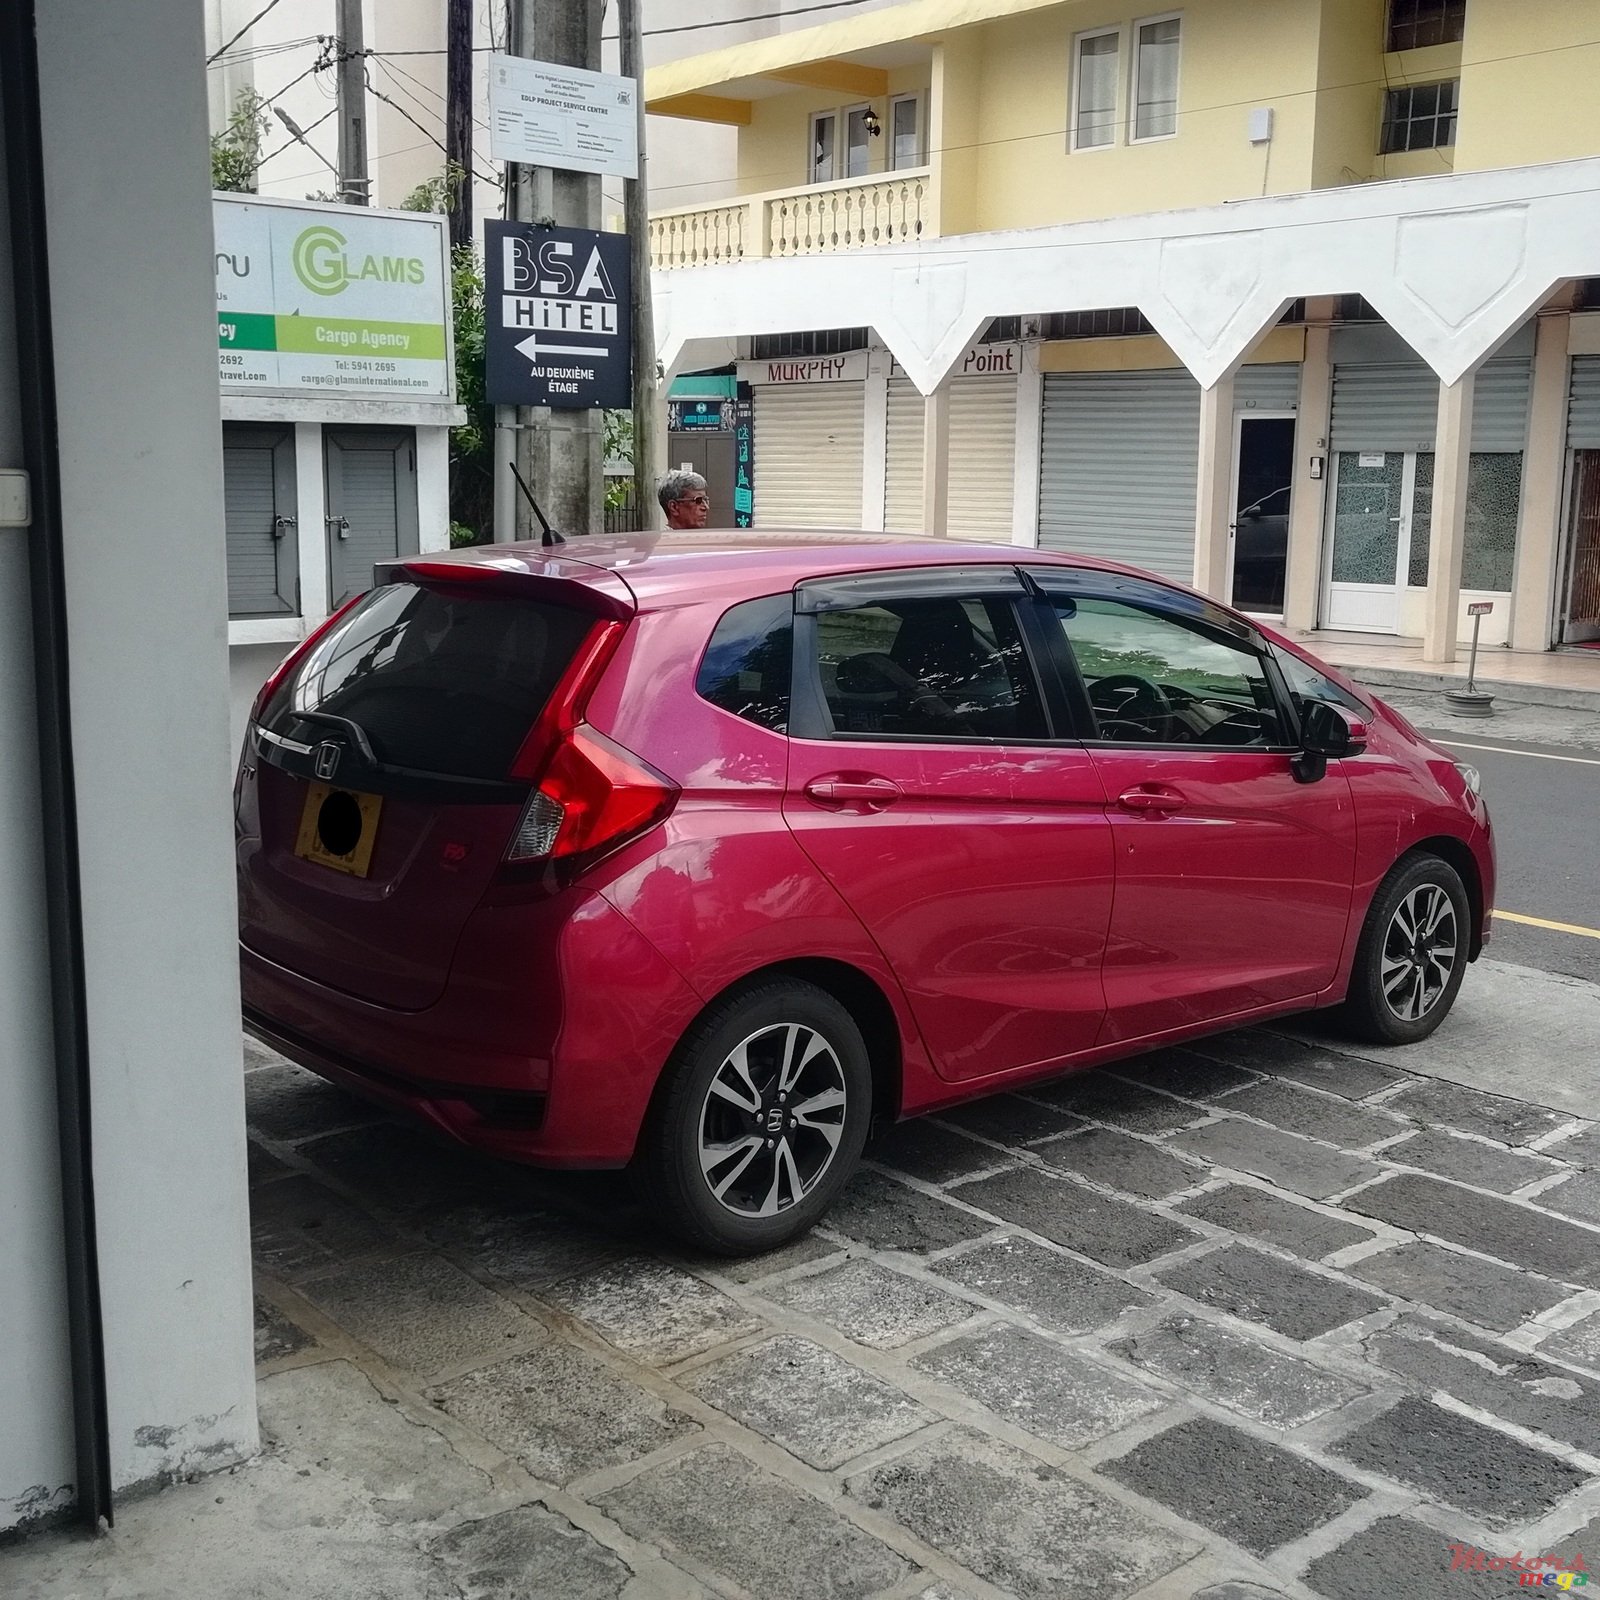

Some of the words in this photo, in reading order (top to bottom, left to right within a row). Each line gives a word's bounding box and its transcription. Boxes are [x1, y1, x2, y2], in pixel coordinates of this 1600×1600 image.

[521, 94, 537, 102] EDLP
[537, 97, 562, 107] PROJECT
[563, 102, 586, 112] SERVICE
[587, 105, 608, 115] CENTRE
[502, 236, 617, 300] BSA
[316, 326, 357, 347] Cargo
[361, 329, 410, 350] Agency
[220, 355, 243, 365] 2692
[335, 360, 350, 370] Tel:
[351, 361, 372, 371] 5941
[375, 362, 396, 372] 2695
[963, 348, 1013, 372] Point
[220, 370, 267, 381] travel.com
[531, 367, 545, 378] AU
[546, 366, 595, 380] DEUXIÈME
[768, 357, 845, 381] MURPHY
[301, 374, 429, 387] cargo@glamsinternational.com
[548, 380, 579, 393] ÉTAGE
